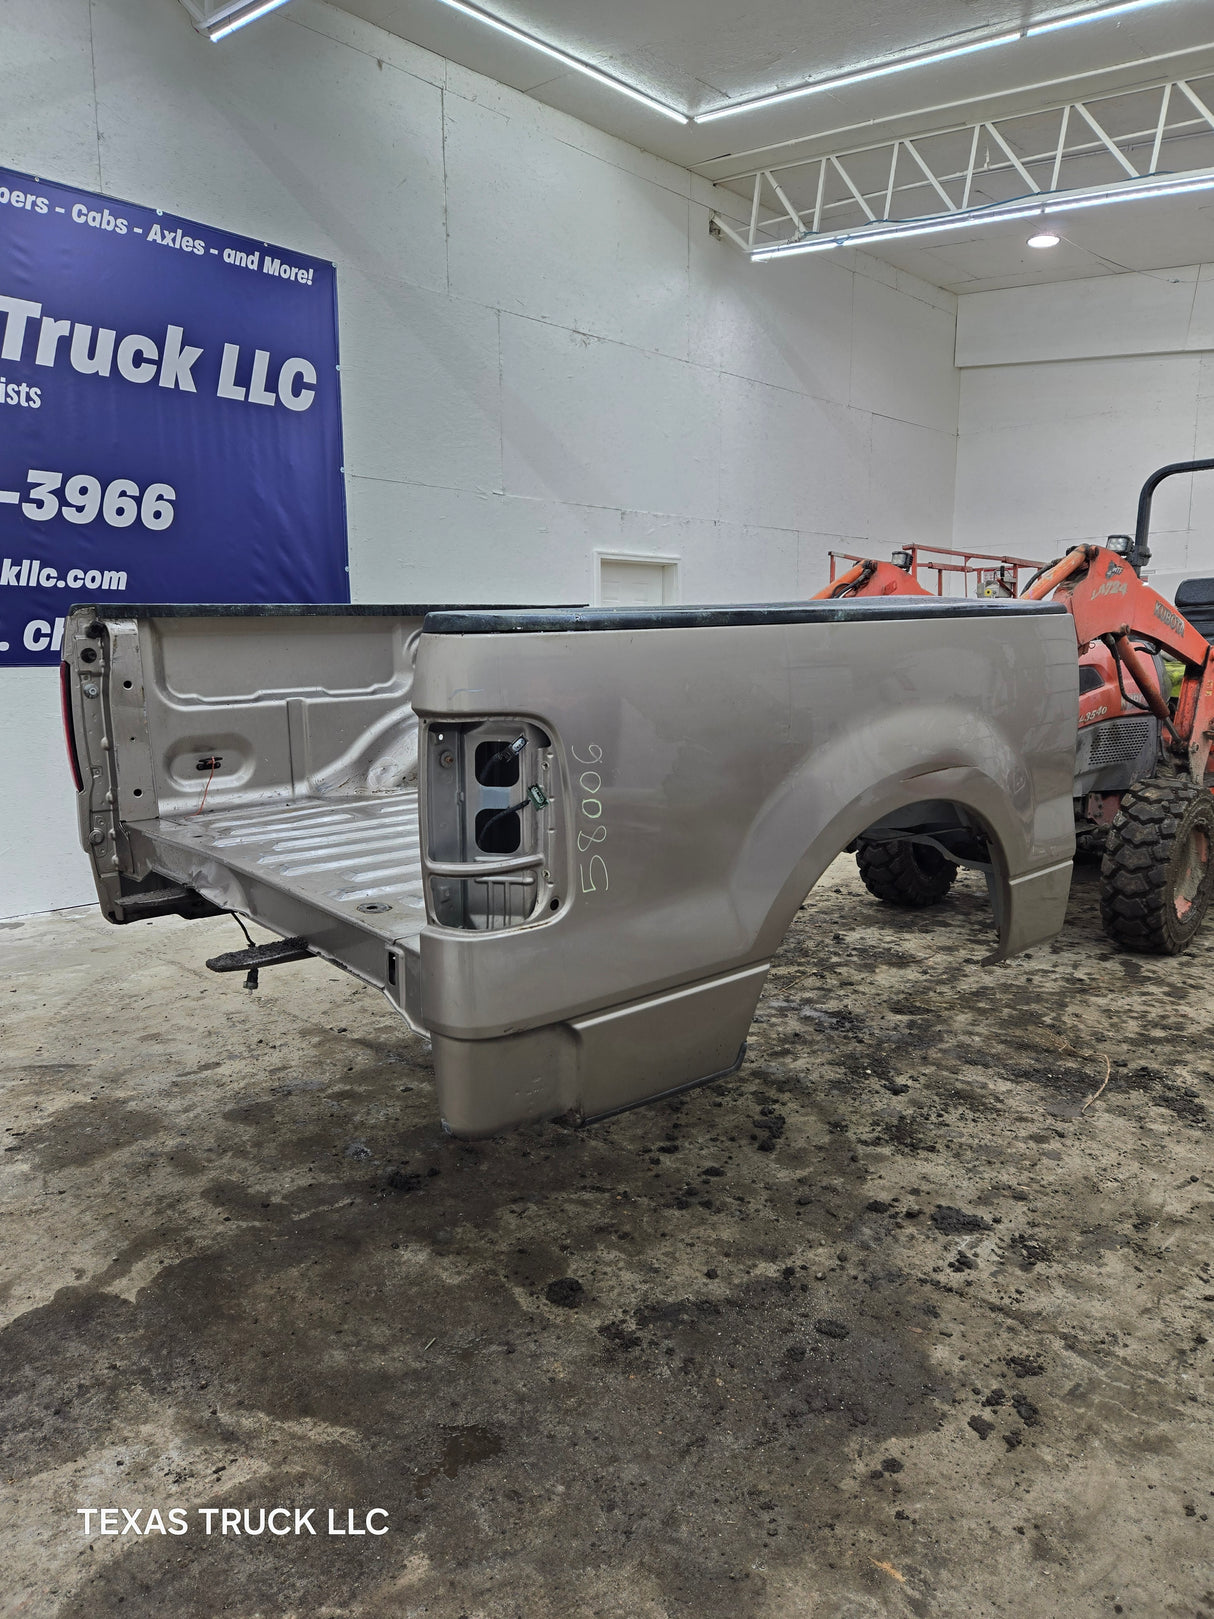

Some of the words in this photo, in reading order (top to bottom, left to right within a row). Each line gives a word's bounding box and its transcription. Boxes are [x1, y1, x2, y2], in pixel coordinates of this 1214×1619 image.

[72, 203, 128, 235] Cabs
[147, 224, 205, 255] Axles
[223, 247, 259, 270] and
[263, 256, 314, 285] More!
[0, 294, 204, 393] Truck
[217, 342, 317, 411] LLC
[0, 558, 128, 590] kllc.com
[1154, 599, 1185, 638] KUBOTA
[572, 744, 609, 893] 58006
